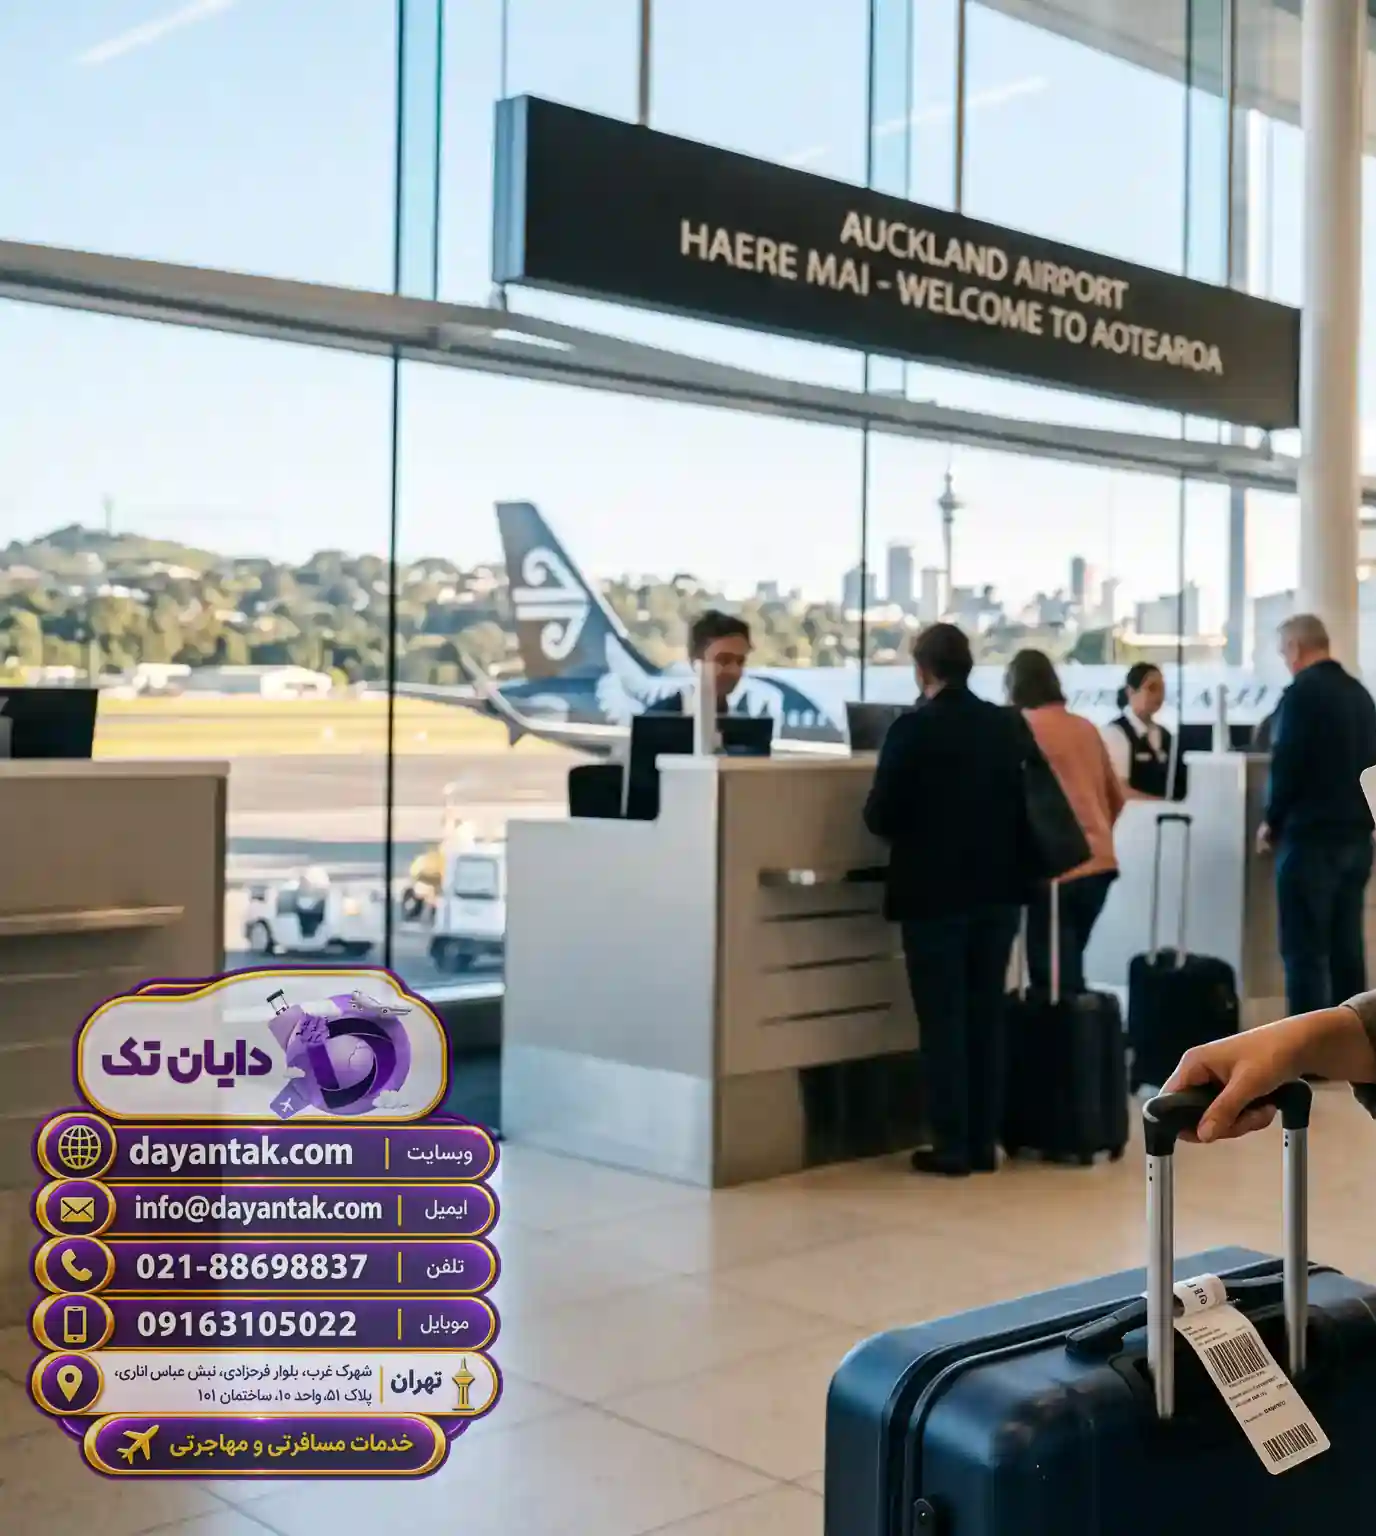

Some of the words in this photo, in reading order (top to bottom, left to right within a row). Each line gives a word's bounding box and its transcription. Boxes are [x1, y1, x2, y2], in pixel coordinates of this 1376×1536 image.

[680, 219, 799, 281] HAERE
[806, 248, 870, 297] MAI
[896, 269, 1044, 336] WELCOME
[1049, 305, 1087, 344] TO
[1091, 318, 1224, 375] AOTEAROA
[840, 210, 1008, 281] AUCKLAND
[1013, 256, 1129, 311] AIRPORT
